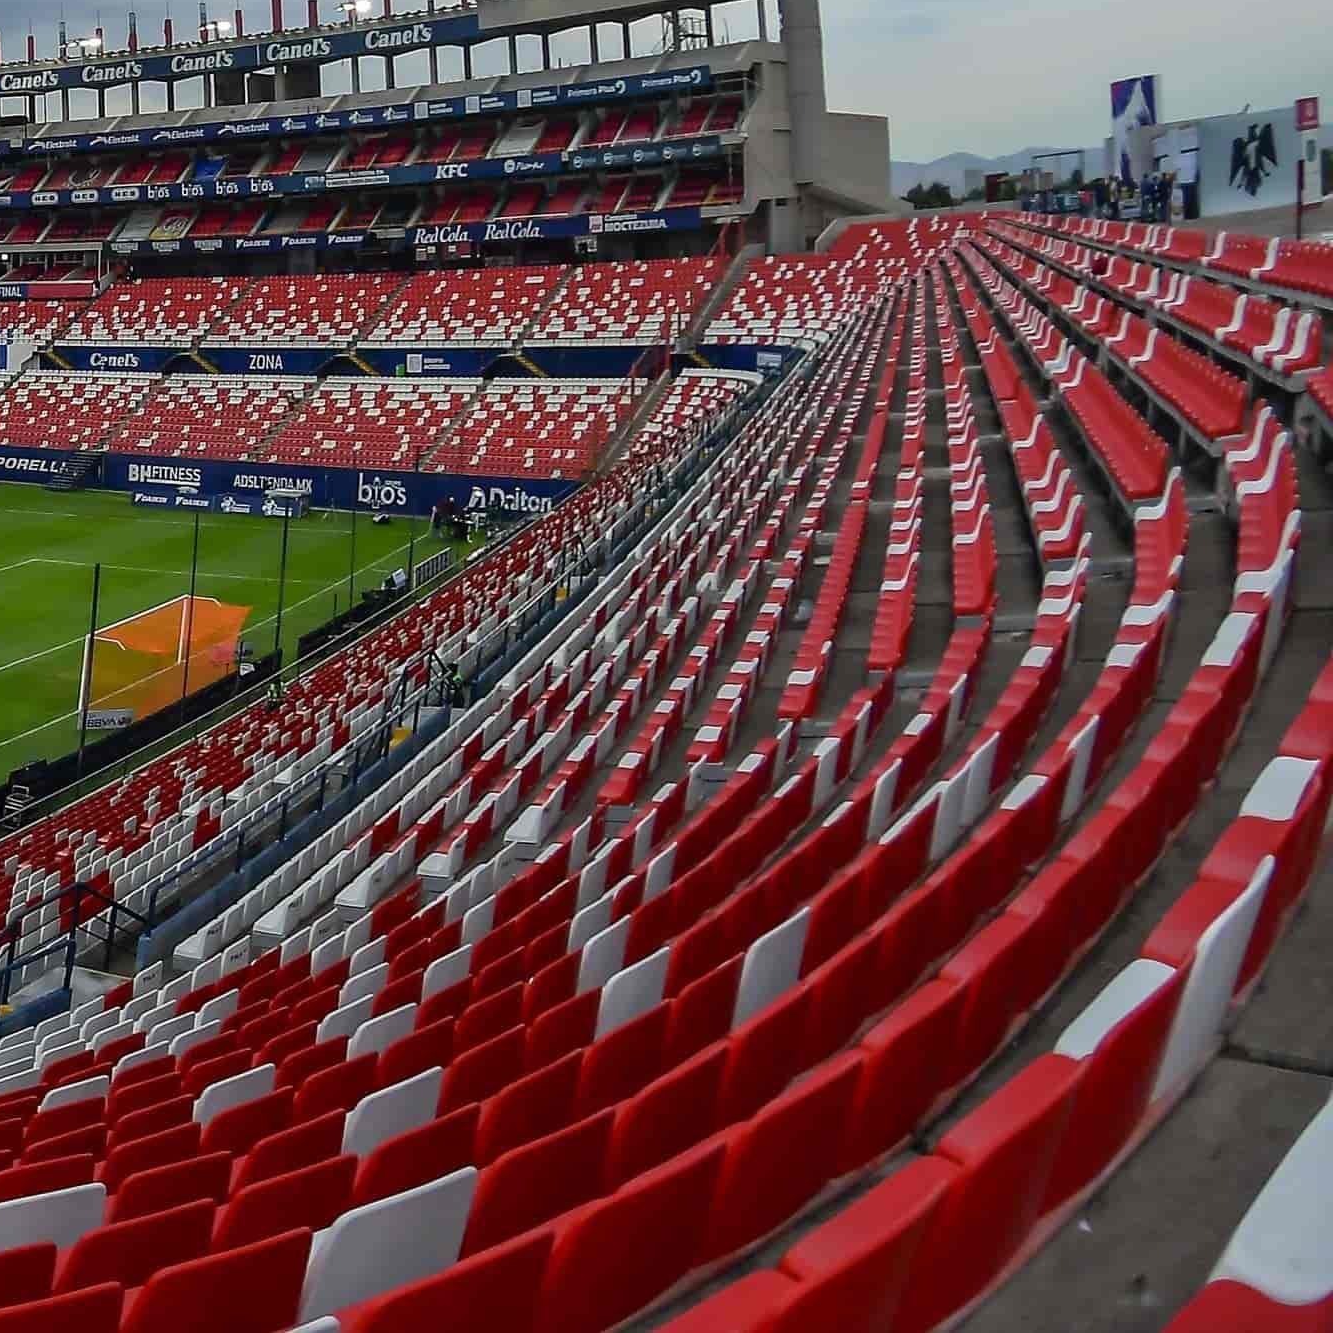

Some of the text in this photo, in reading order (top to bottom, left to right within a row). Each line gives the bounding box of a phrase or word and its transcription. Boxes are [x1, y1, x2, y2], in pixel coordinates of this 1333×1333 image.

[365, 24, 432, 49] Canel's
[171, 50, 234, 72] Canel's
[266, 39, 332, 62] Canel's
[0, 71, 59, 91] Canel's
[82, 61, 143, 83] Canel's
[435, 164, 468, 179] KFC
[249, 354, 283, 371] ZONA
[489, 487, 553, 512] Dalton
